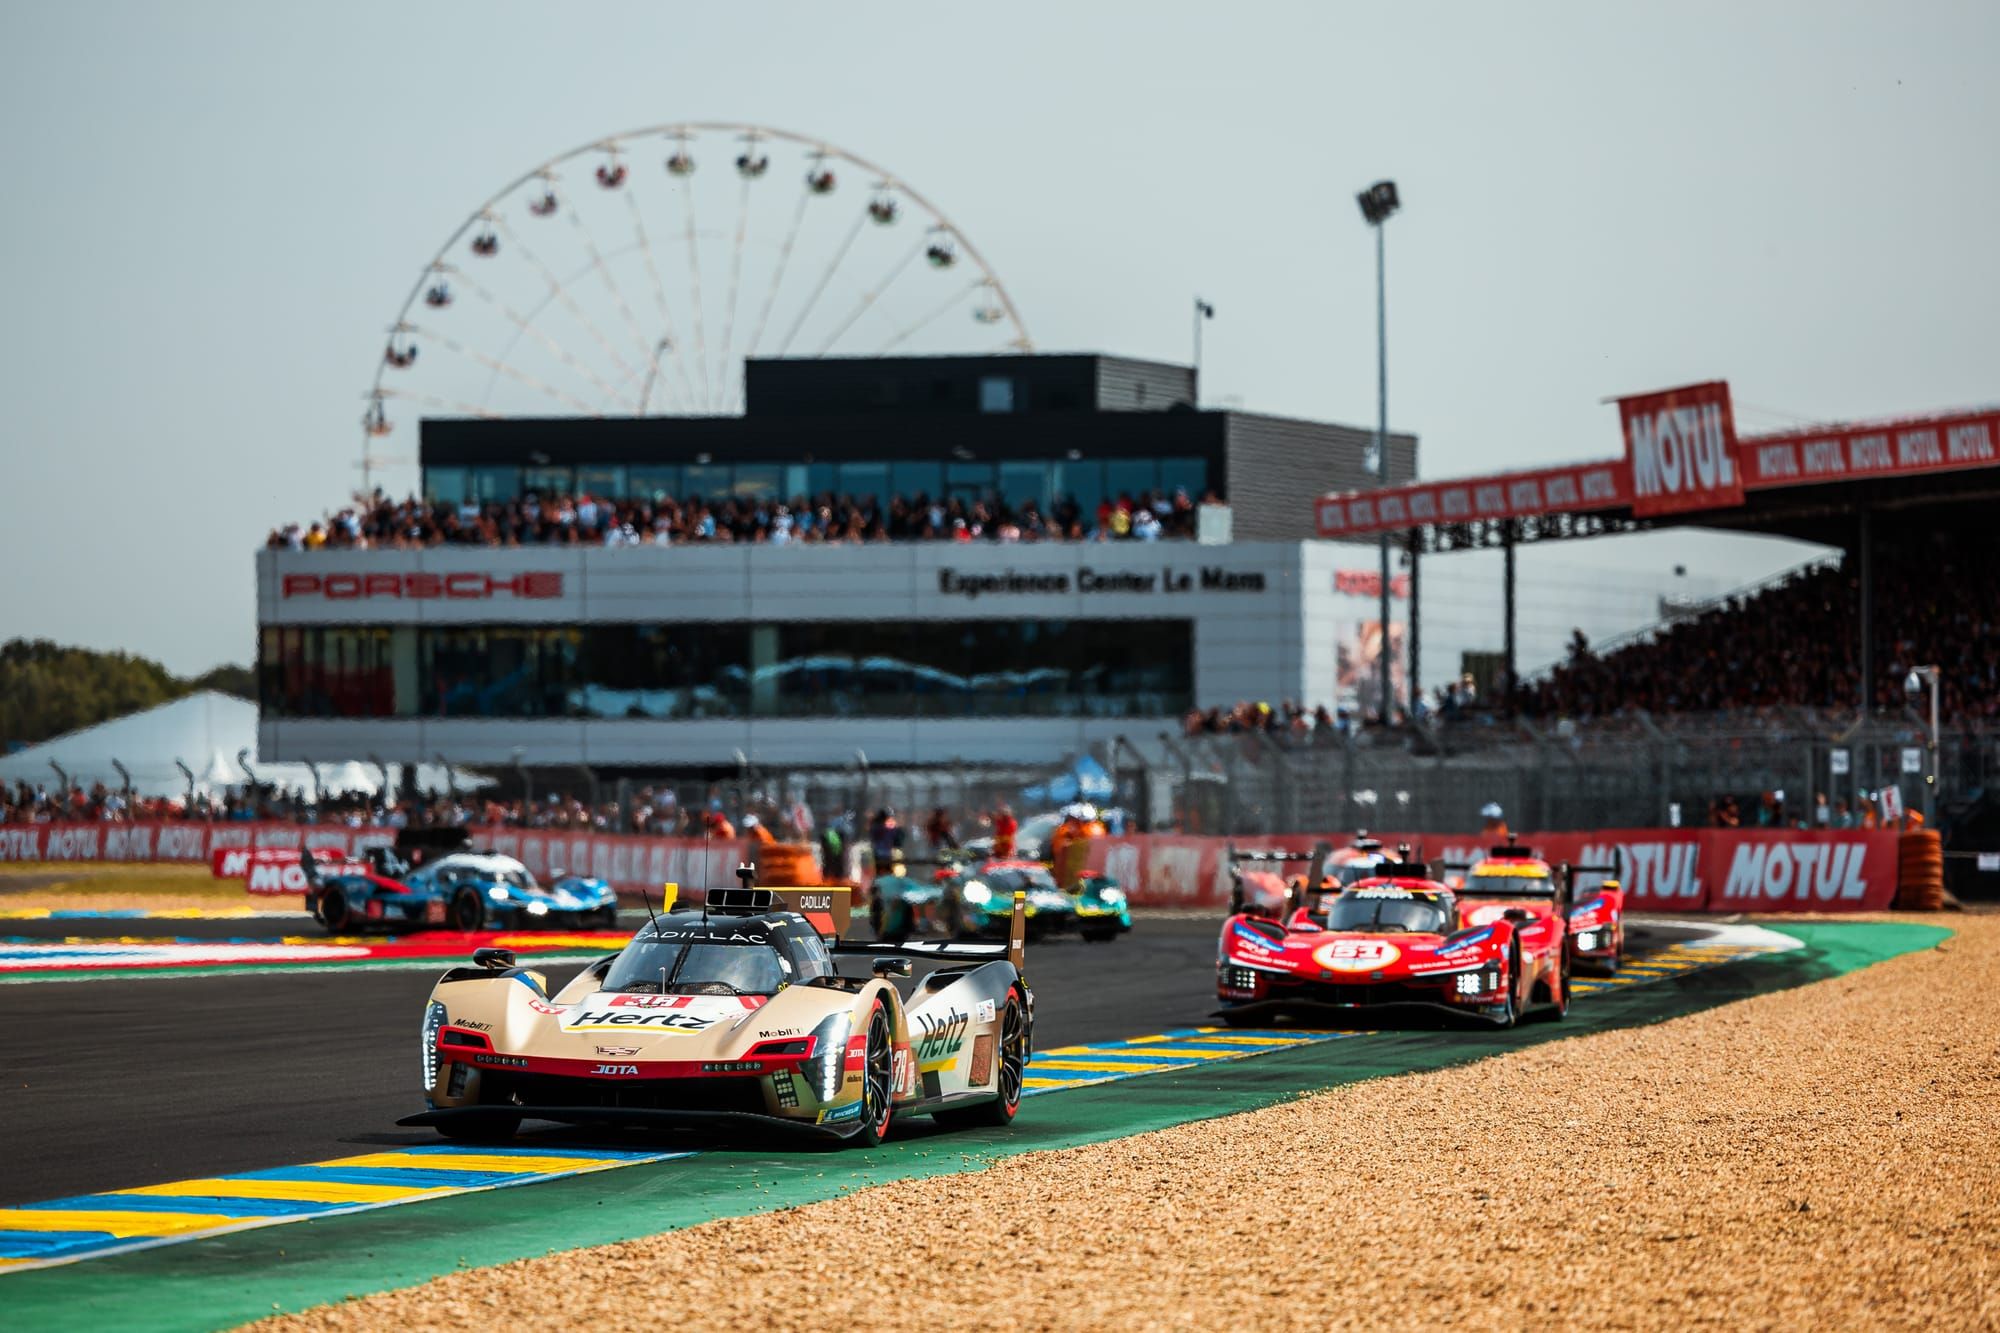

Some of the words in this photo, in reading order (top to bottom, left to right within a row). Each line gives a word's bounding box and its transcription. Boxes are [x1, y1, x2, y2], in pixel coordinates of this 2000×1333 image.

[1630, 403, 1734, 496] MOTUL
[282, 572, 564, 599] PORSCHE
[938, 567, 1070, 600] Experience
[1076, 567, 1156, 593] Center
[1163, 567, 1193, 593] Le
[1199, 567, 1267, 593] Mans
[1724, 843, 1868, 899] MOTUL
[800, 895, 831, 909] CADILLAC
[636, 930, 767, 944] CADILLAC
[1332, 945, 1382, 959] 51
[454, 1018, 482, 1030] Mobil
[571, 1012, 715, 1029] Hertz
[759, 1028, 793, 1038] Mobil
[917, 1007, 968, 1059] Hertz
[591, 1064, 639, 1075] JOTA
